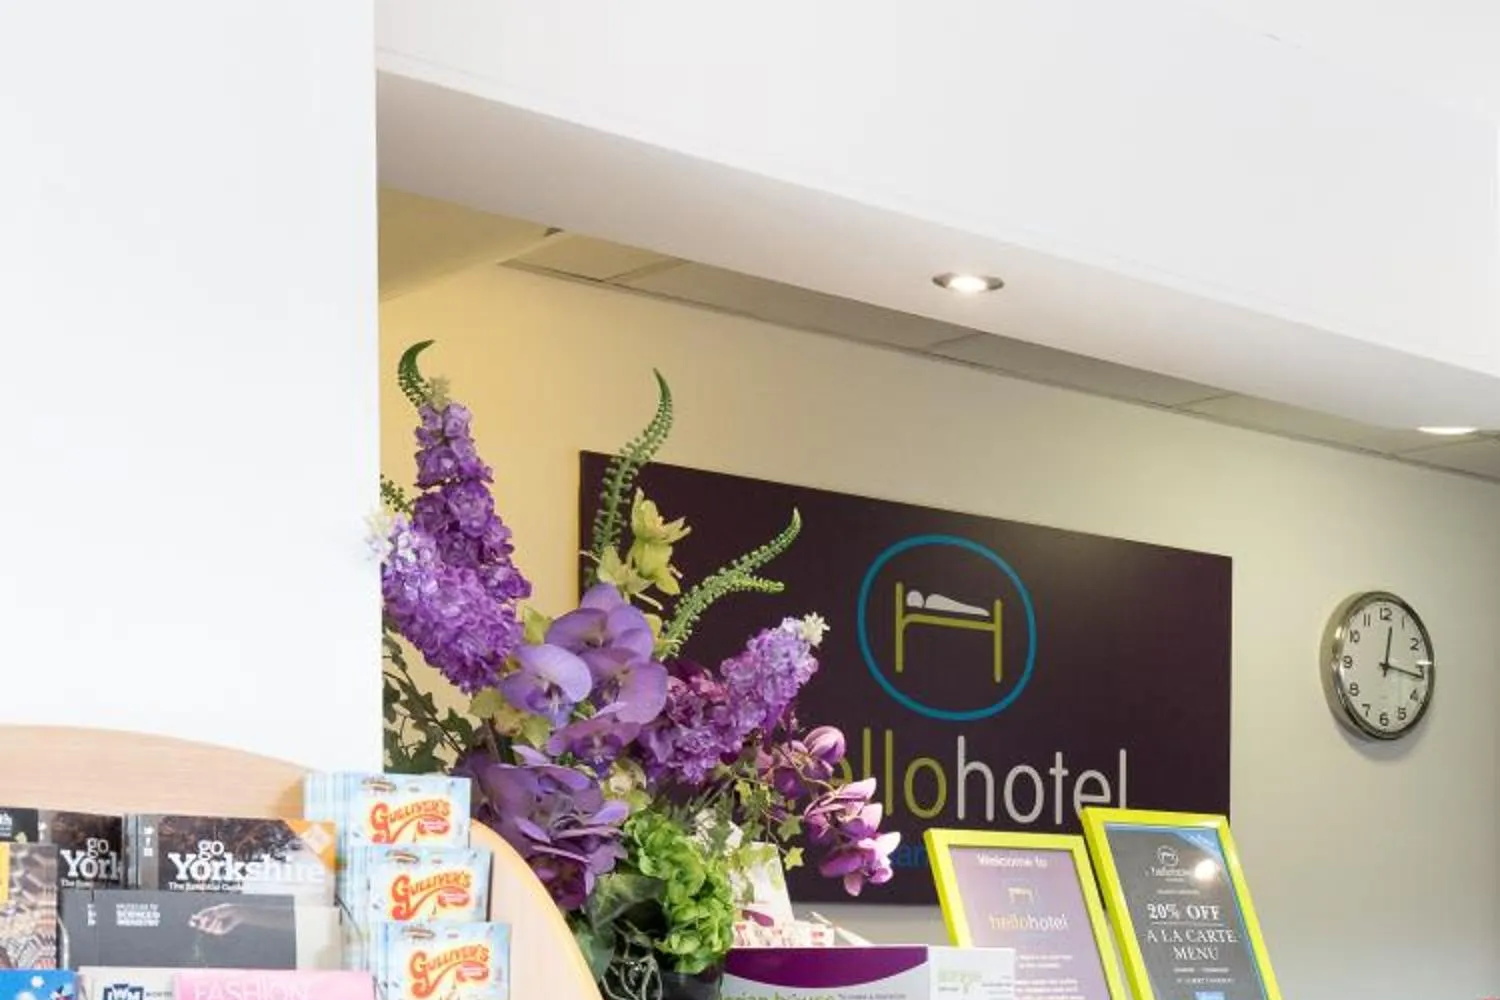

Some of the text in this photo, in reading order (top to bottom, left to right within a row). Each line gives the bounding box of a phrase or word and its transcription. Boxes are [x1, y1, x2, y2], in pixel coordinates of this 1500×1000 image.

[1363, 614, 1371, 627] 11
[1380, 607, 1392, 621] 12
[1350, 630, 1360, 643] 10
[1410, 638, 1419, 650] 2
[1350, 682, 1360, 696] 8
[1362, 704, 1371, 717] 7
[1399, 708, 1407, 720] 5
[1380, 713, 1389, 726] 6
[832, 727, 1127, 824] llohotel
[87, 838, 108, 858] go
[198, 839, 224, 860] go
[168, 849, 326, 881] Yorkshire
[1147, 903, 1221, 921] 20% OFF
[1147, 929, 1238, 943] A LA CARTE
[1173, 946, 1218, 961] MENU
